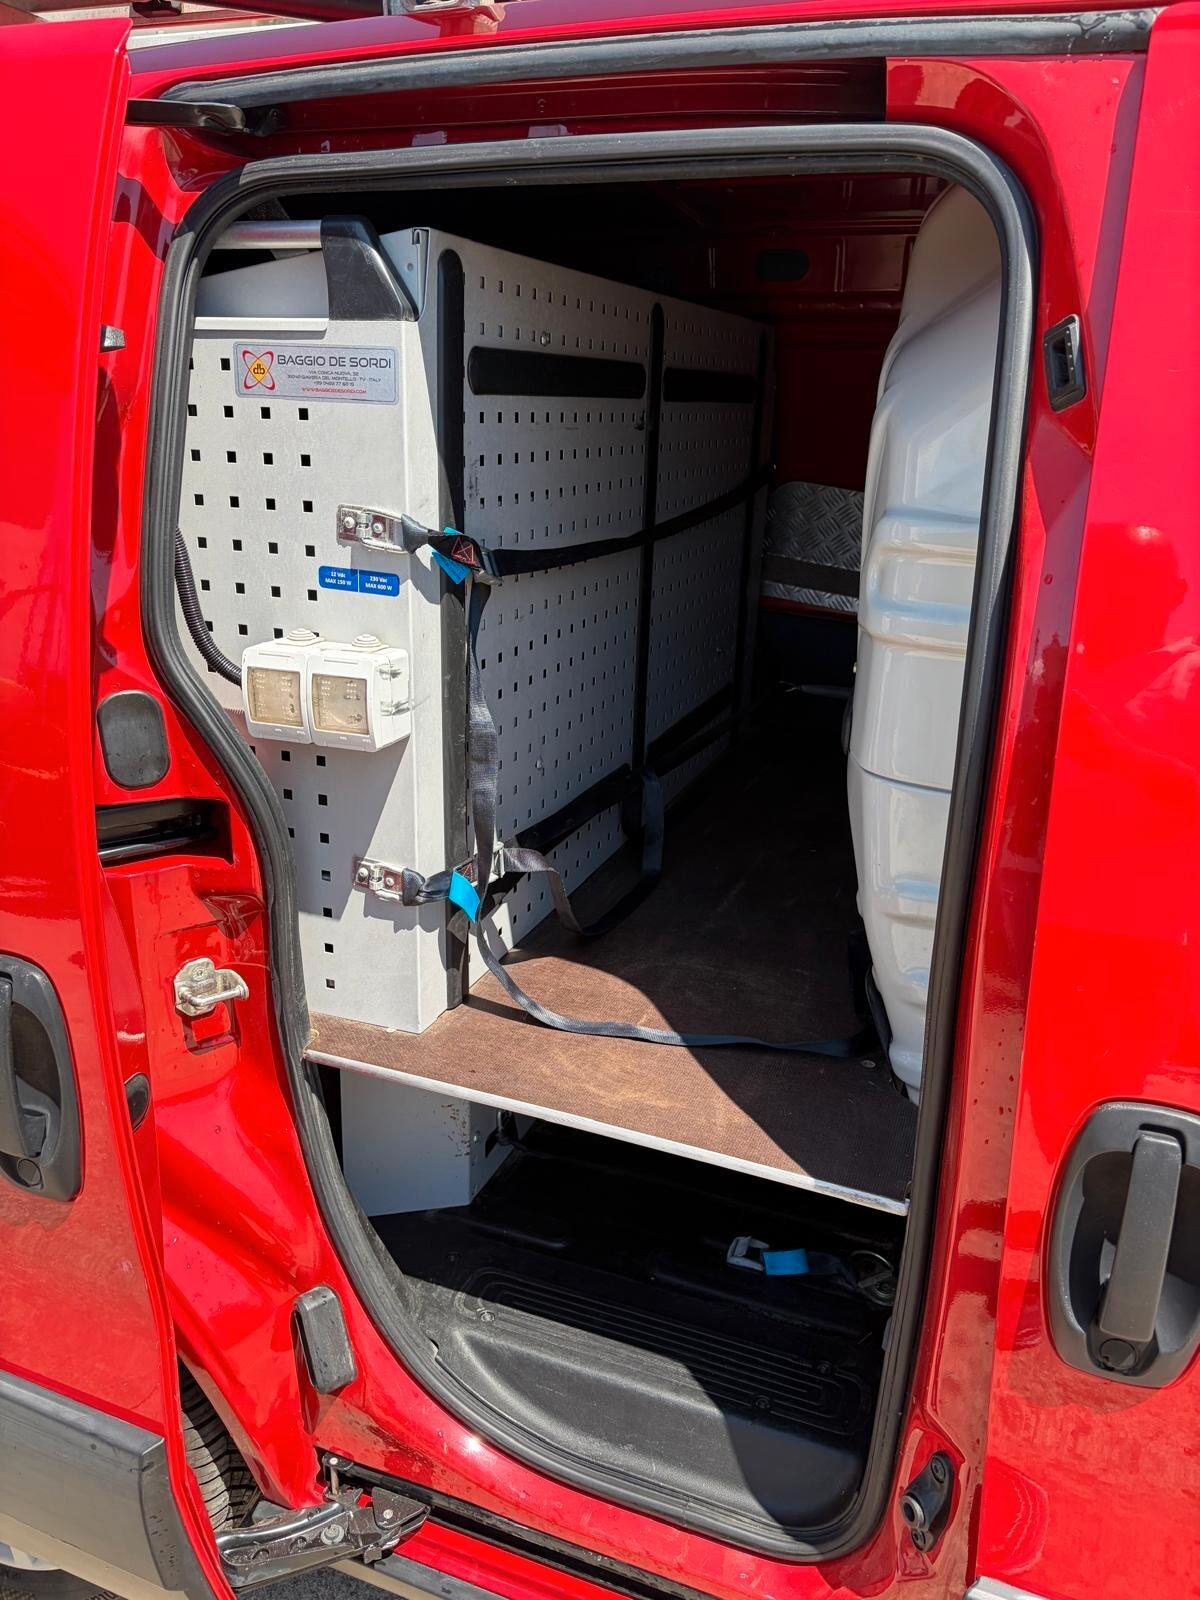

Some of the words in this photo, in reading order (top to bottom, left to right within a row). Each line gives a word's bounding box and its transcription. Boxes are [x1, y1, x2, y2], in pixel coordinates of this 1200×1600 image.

[277, 354, 326, 366] BAGGIO
[329, 356, 346, 367] DE
[349, 357, 391, 369] SORDI
